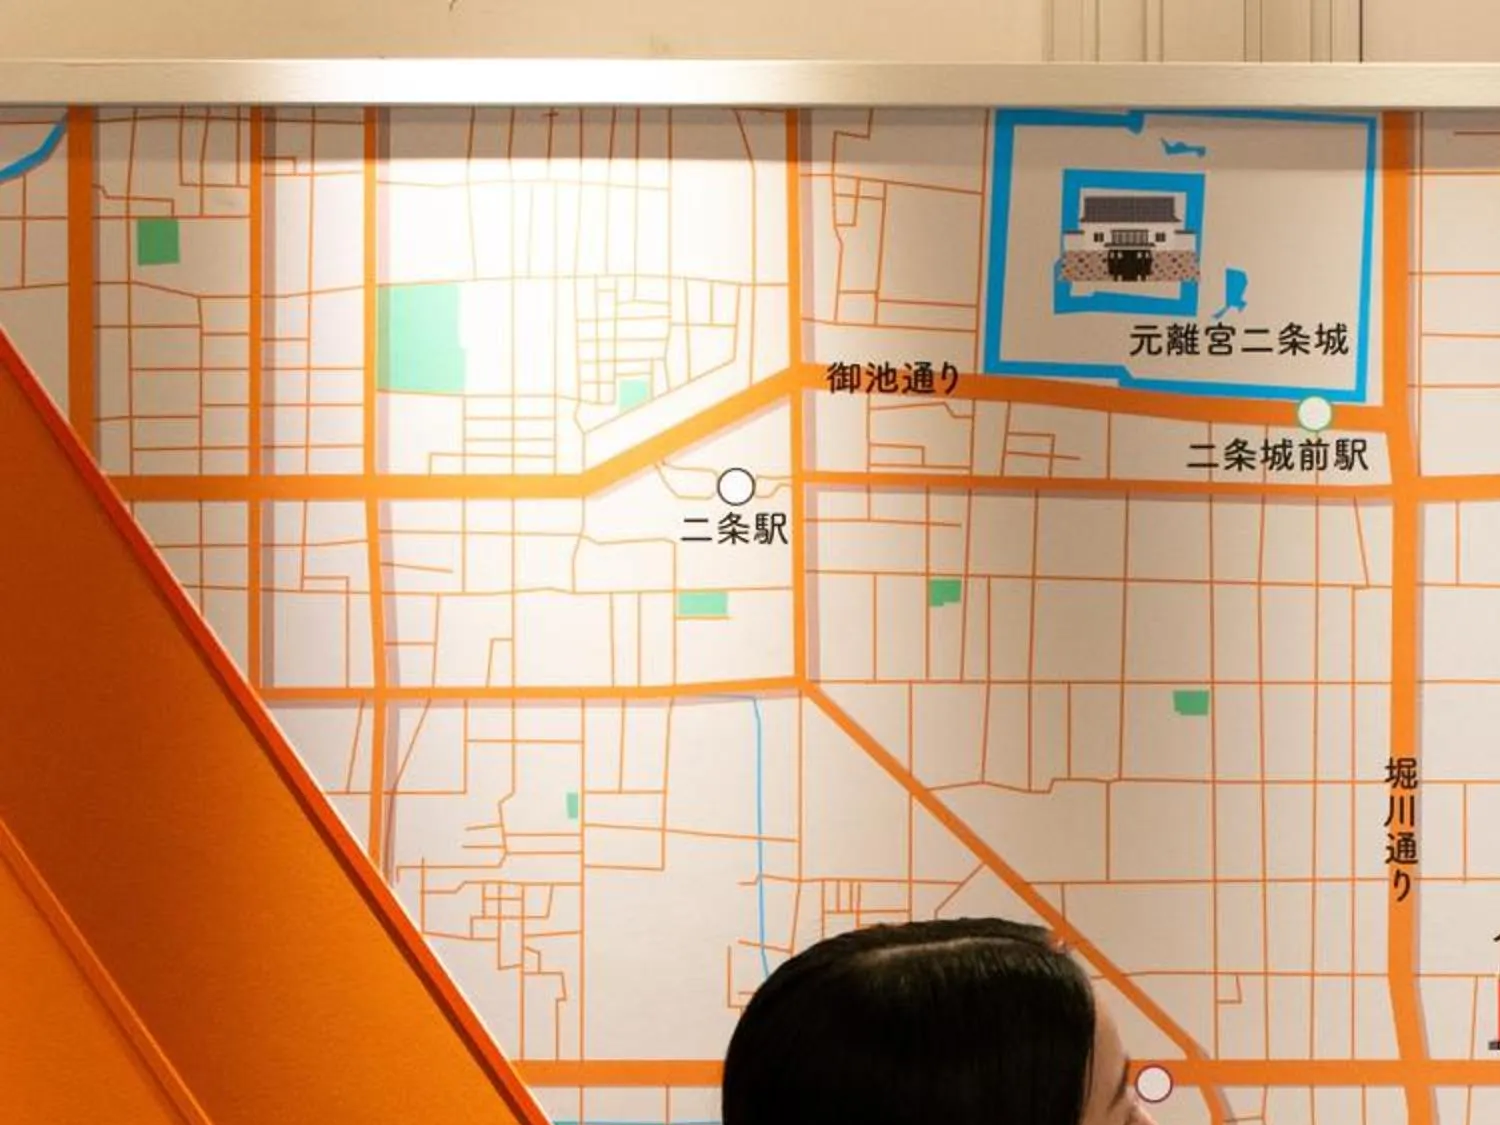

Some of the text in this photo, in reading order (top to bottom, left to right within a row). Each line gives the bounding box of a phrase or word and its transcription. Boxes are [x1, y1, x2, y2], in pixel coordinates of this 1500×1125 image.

[1129, 323, 1349, 355] 元離宮二条城
[826, 362, 960, 394] 御池通り
[1187, 438, 1368, 471] 二条城前駅
[680, 513, 788, 545] 二条駅
[1383, 757, 1418, 902] 堀川通り
